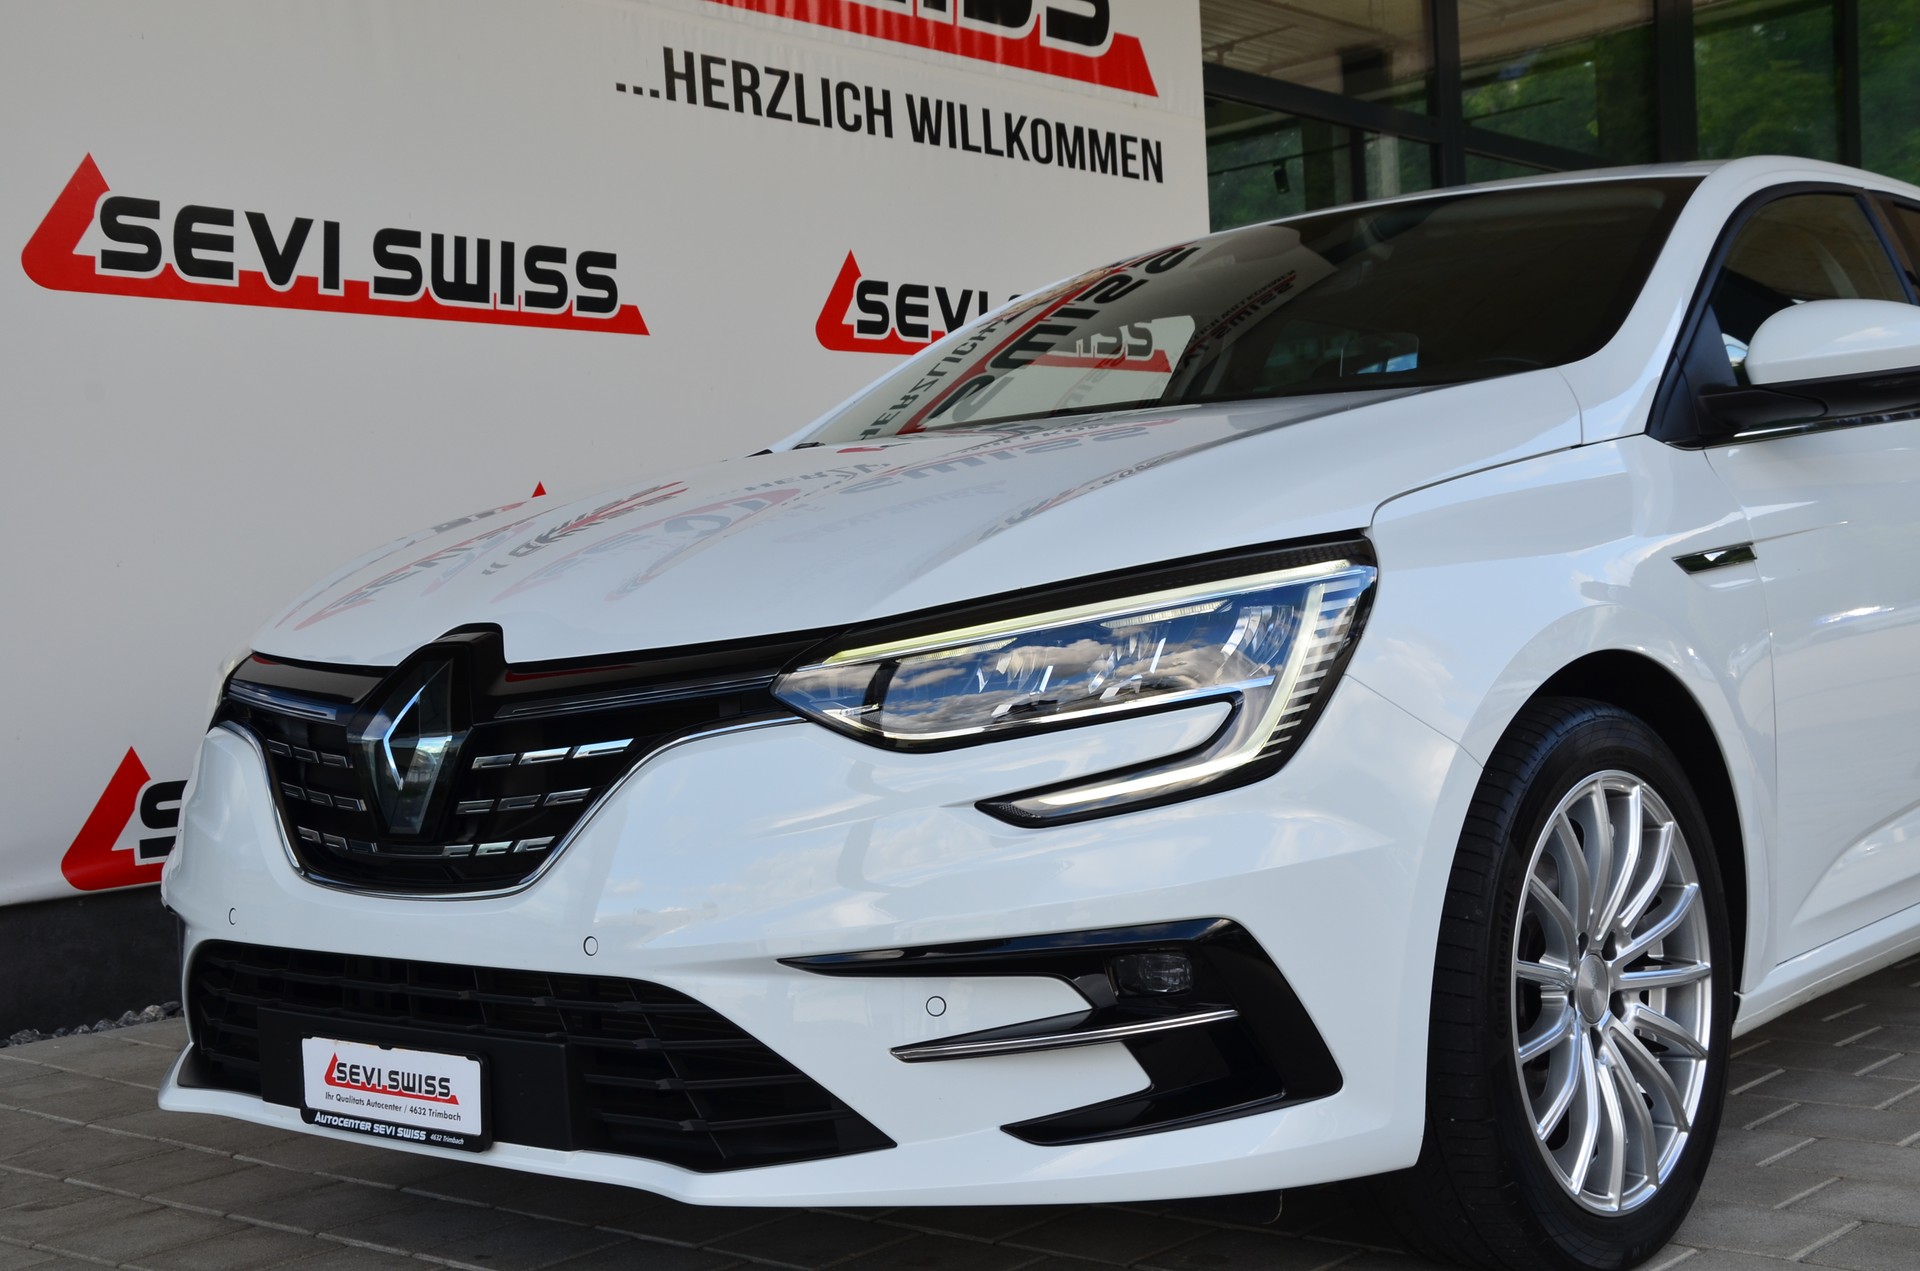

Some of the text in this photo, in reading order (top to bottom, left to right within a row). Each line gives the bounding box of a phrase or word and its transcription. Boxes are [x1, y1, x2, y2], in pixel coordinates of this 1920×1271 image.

[906, 94, 1164, 184] WILLKOMMEN
[100, 195, 619, 315] SEVI SWISS
[336, 1062, 451, 1098] SEVI SWISS
[325, 1091, 335, 1100] Ihr
[366, 1098, 402, 1112] Autocenter
[409, 1105, 427, 1116] 4632
[428, 1108, 461, 1121] Trimbach
[373, 1123, 396, 1136] SEVI
[396, 1127, 427, 1141] SWISS
[429, 1132, 442, 1142] 4632
[442, 1135, 464, 1145] Trimbach
